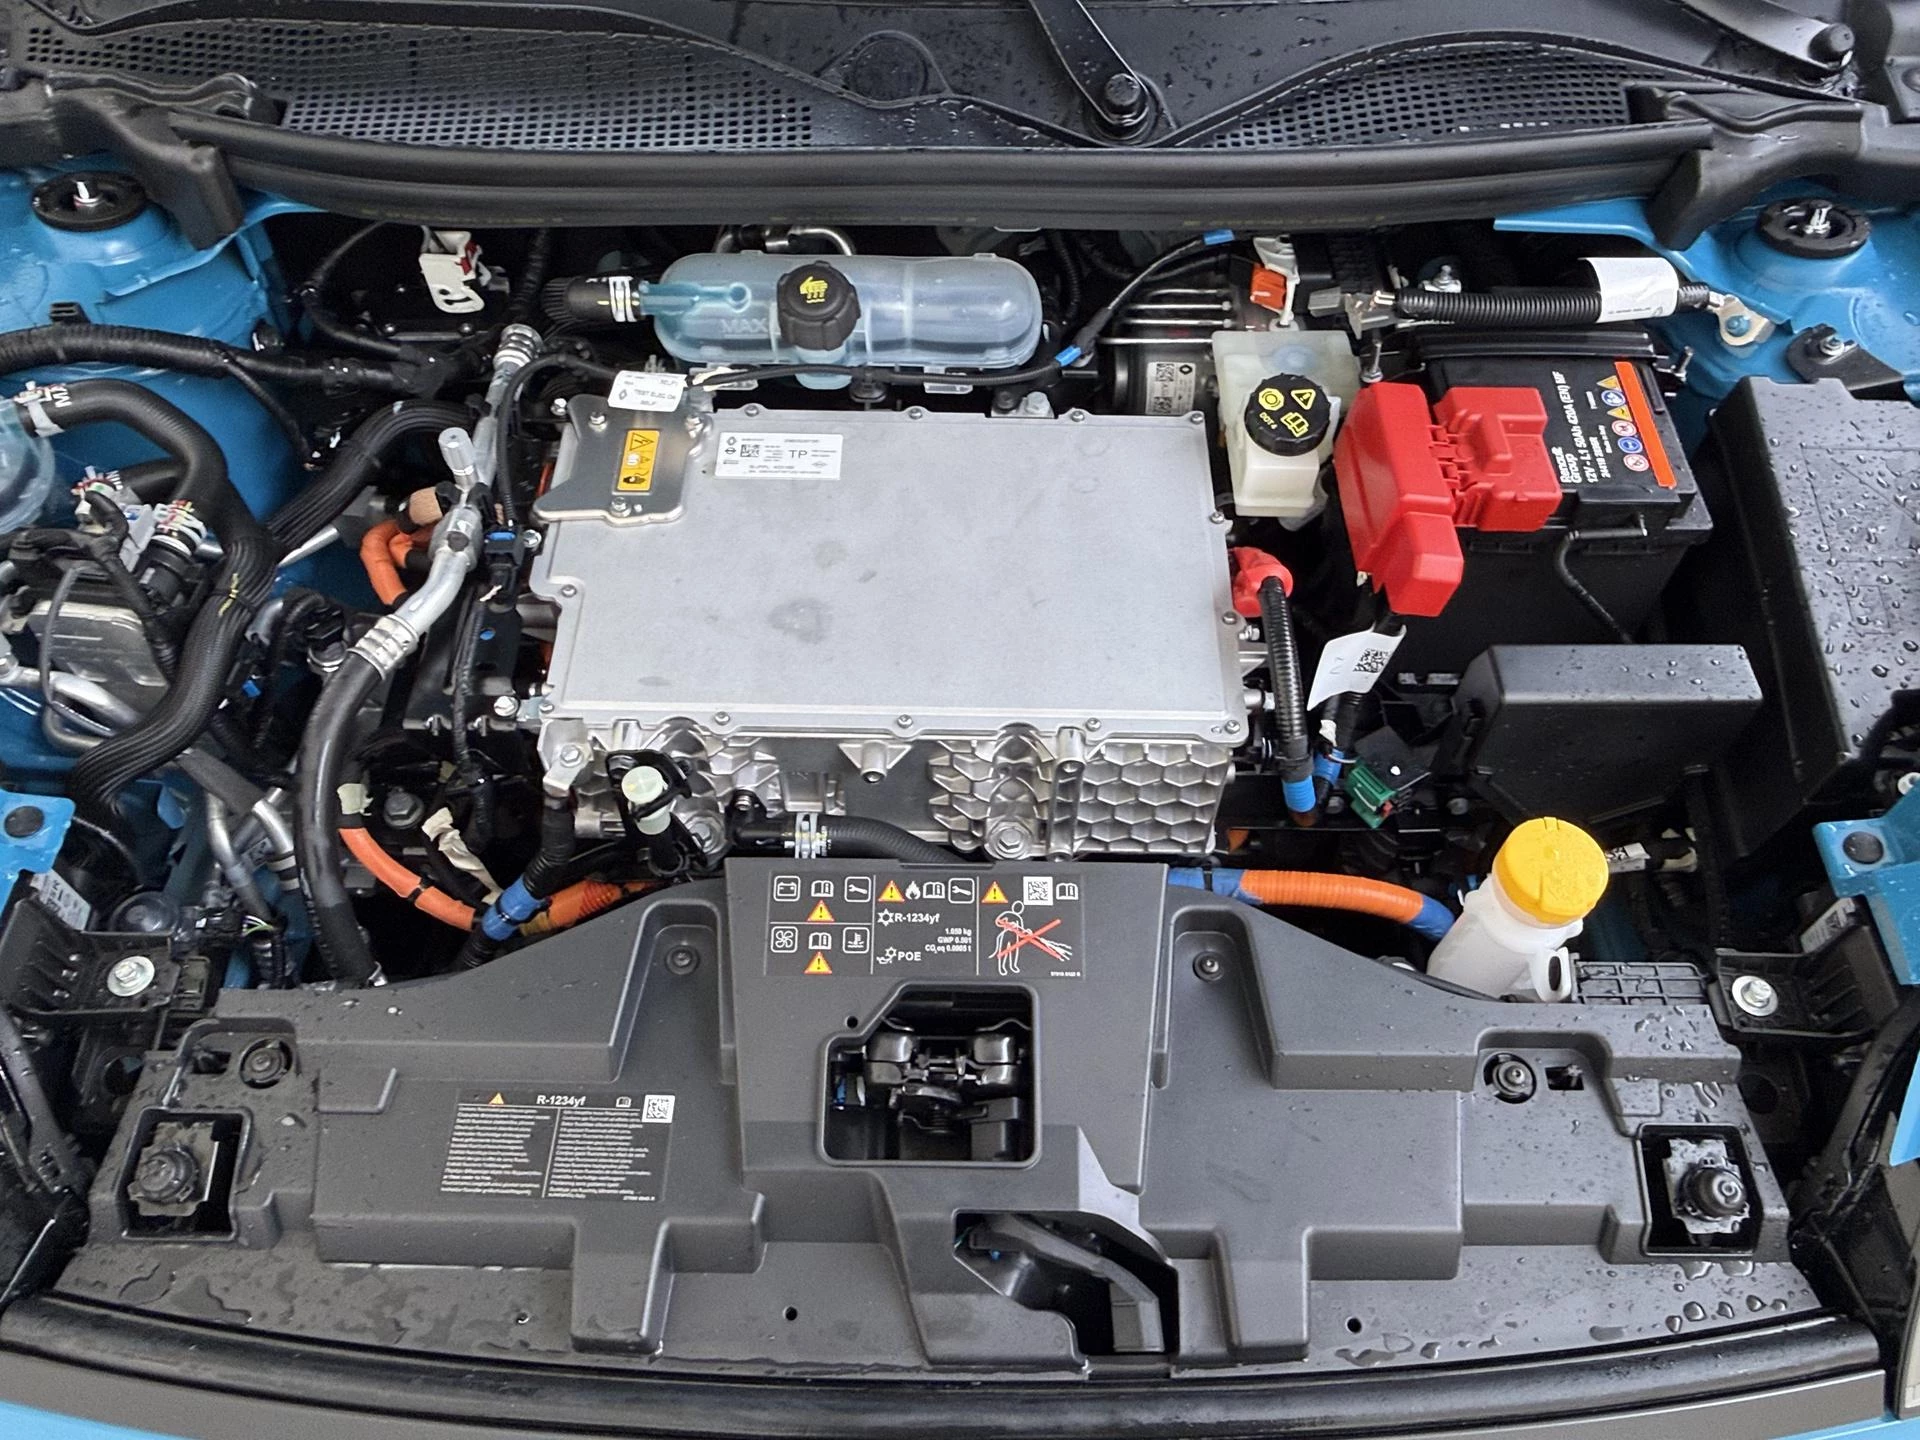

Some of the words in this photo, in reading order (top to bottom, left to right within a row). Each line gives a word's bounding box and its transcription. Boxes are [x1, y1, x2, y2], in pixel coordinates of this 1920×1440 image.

[788, 449, 808, 459] TP
[1565, 453, 1582, 483] Group
[1583, 466, 1599, 483] 12V
[894, 912, 940, 925] R-1234yf
[897, 951, 922, 961] POE
[536, 1094, 586, 1108] R-1234yf
